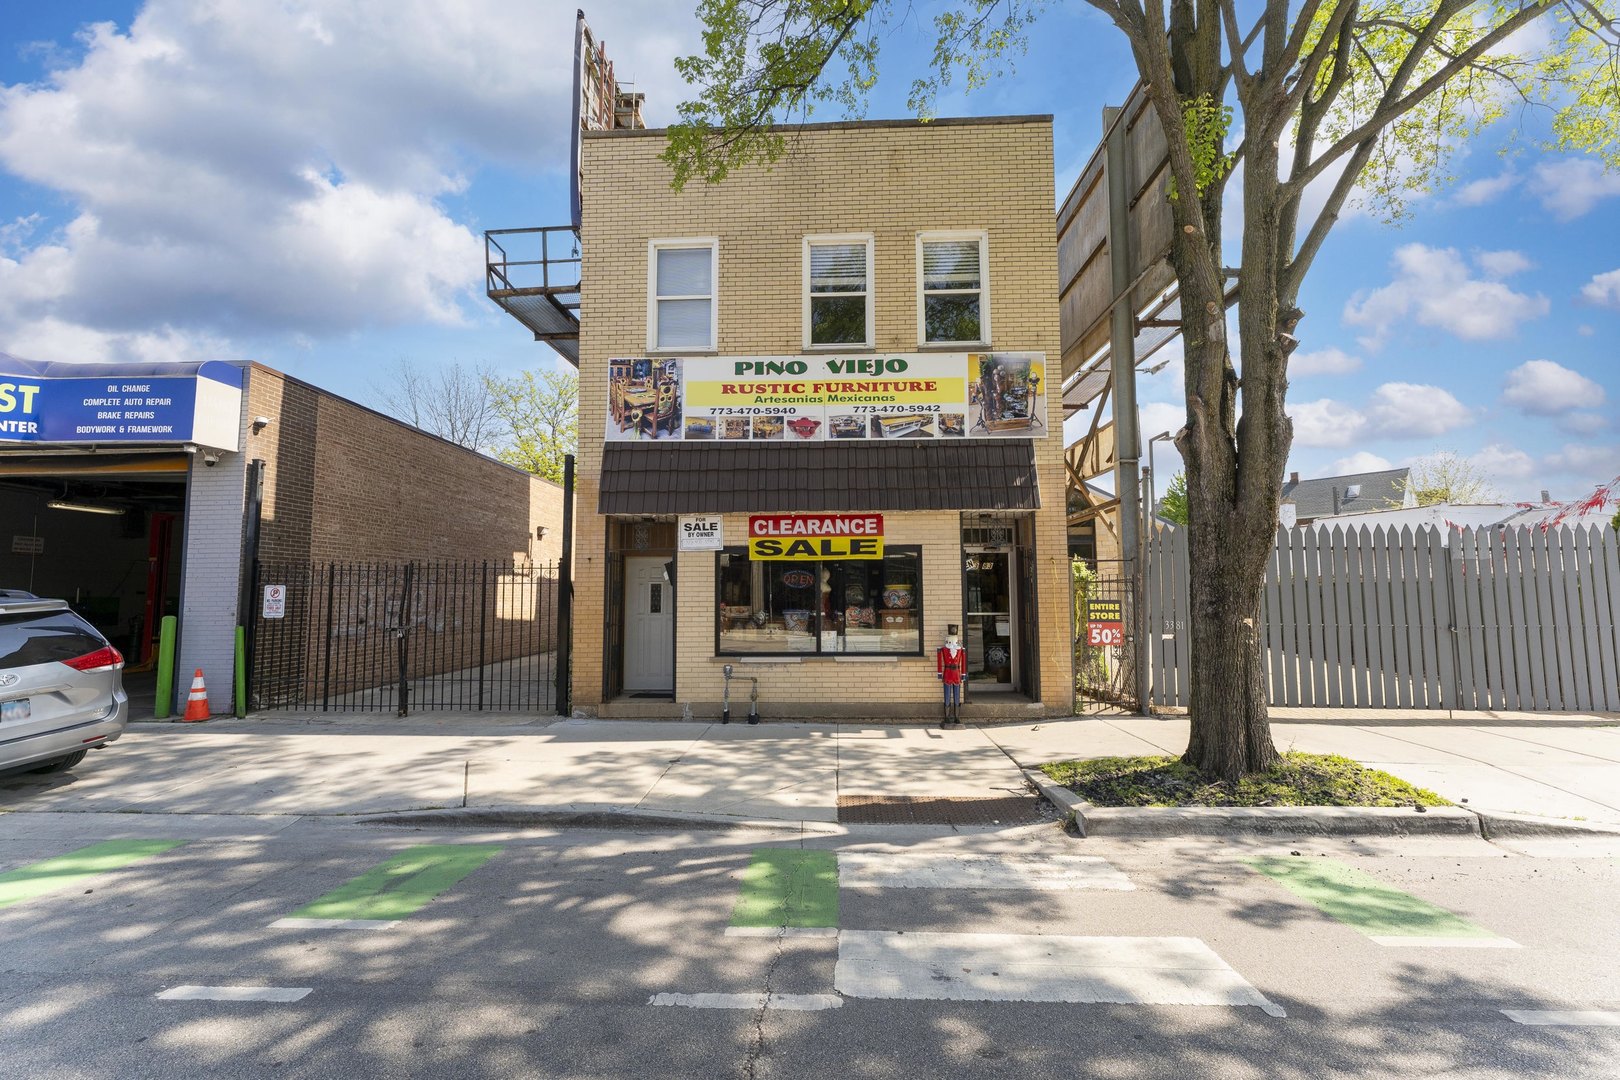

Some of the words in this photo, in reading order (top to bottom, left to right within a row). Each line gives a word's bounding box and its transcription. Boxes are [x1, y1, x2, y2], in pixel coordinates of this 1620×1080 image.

[734, 360, 808, 376] PINO
[826, 358, 909, 376] VIEJO
[122, 385, 150, 393] CHANGE
[721, 383, 805, 395] RUSTIC
[812, 381, 937, 393] FURNITURE
[0, 383, 40, 414] ST
[83, 398, 121, 406] COMPLETE
[123, 398, 143, 406] AUTO
[145, 398, 171, 406] REPAIR
[754, 395, 823, 404] Artesanias
[827, 394, 896, 402] Mexicanas
[710, 407, 796, 415] 773-470-5940
[853, 405, 941, 413] 773-470-5942
[97, 411, 121, 419] BRAKE
[124, 411, 155, 419] REPAIRS
[76, 425, 116, 433] BODYWORK
[127, 425, 173, 433] FRAMEWORK
[684, 522, 718, 531] SALE
[754, 518, 878, 535] CLEARANCE
[754, 538, 878, 557] SALE
[783, 574, 814, 585] OPEN
[1089, 603, 1120, 611] ENTIRE
[1089, 612, 1121, 620] STORE
[1091, 628, 1121, 644] 50%
